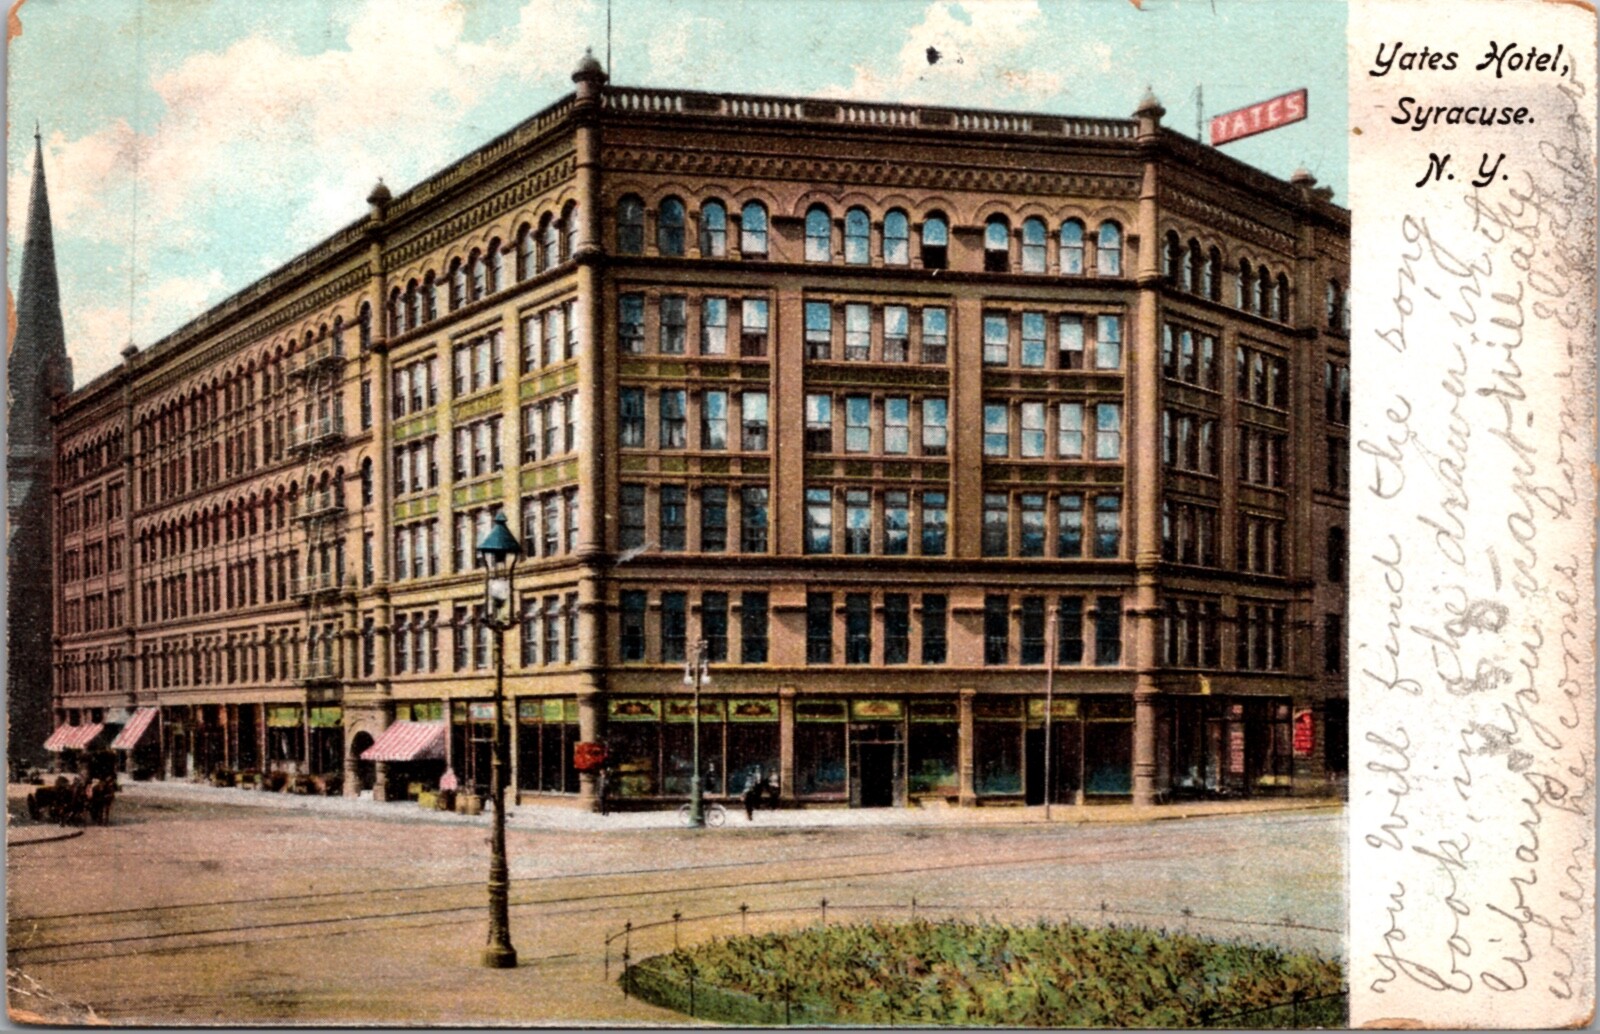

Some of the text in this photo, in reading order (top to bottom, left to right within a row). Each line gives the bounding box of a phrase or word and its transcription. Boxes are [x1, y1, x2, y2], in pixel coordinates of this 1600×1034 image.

[1219, 94, 1302, 138] YATES
[1374, 213, 1473, 352] song
[1356, 394, 1412, 498] the
[1358, 533, 1423, 694] find
